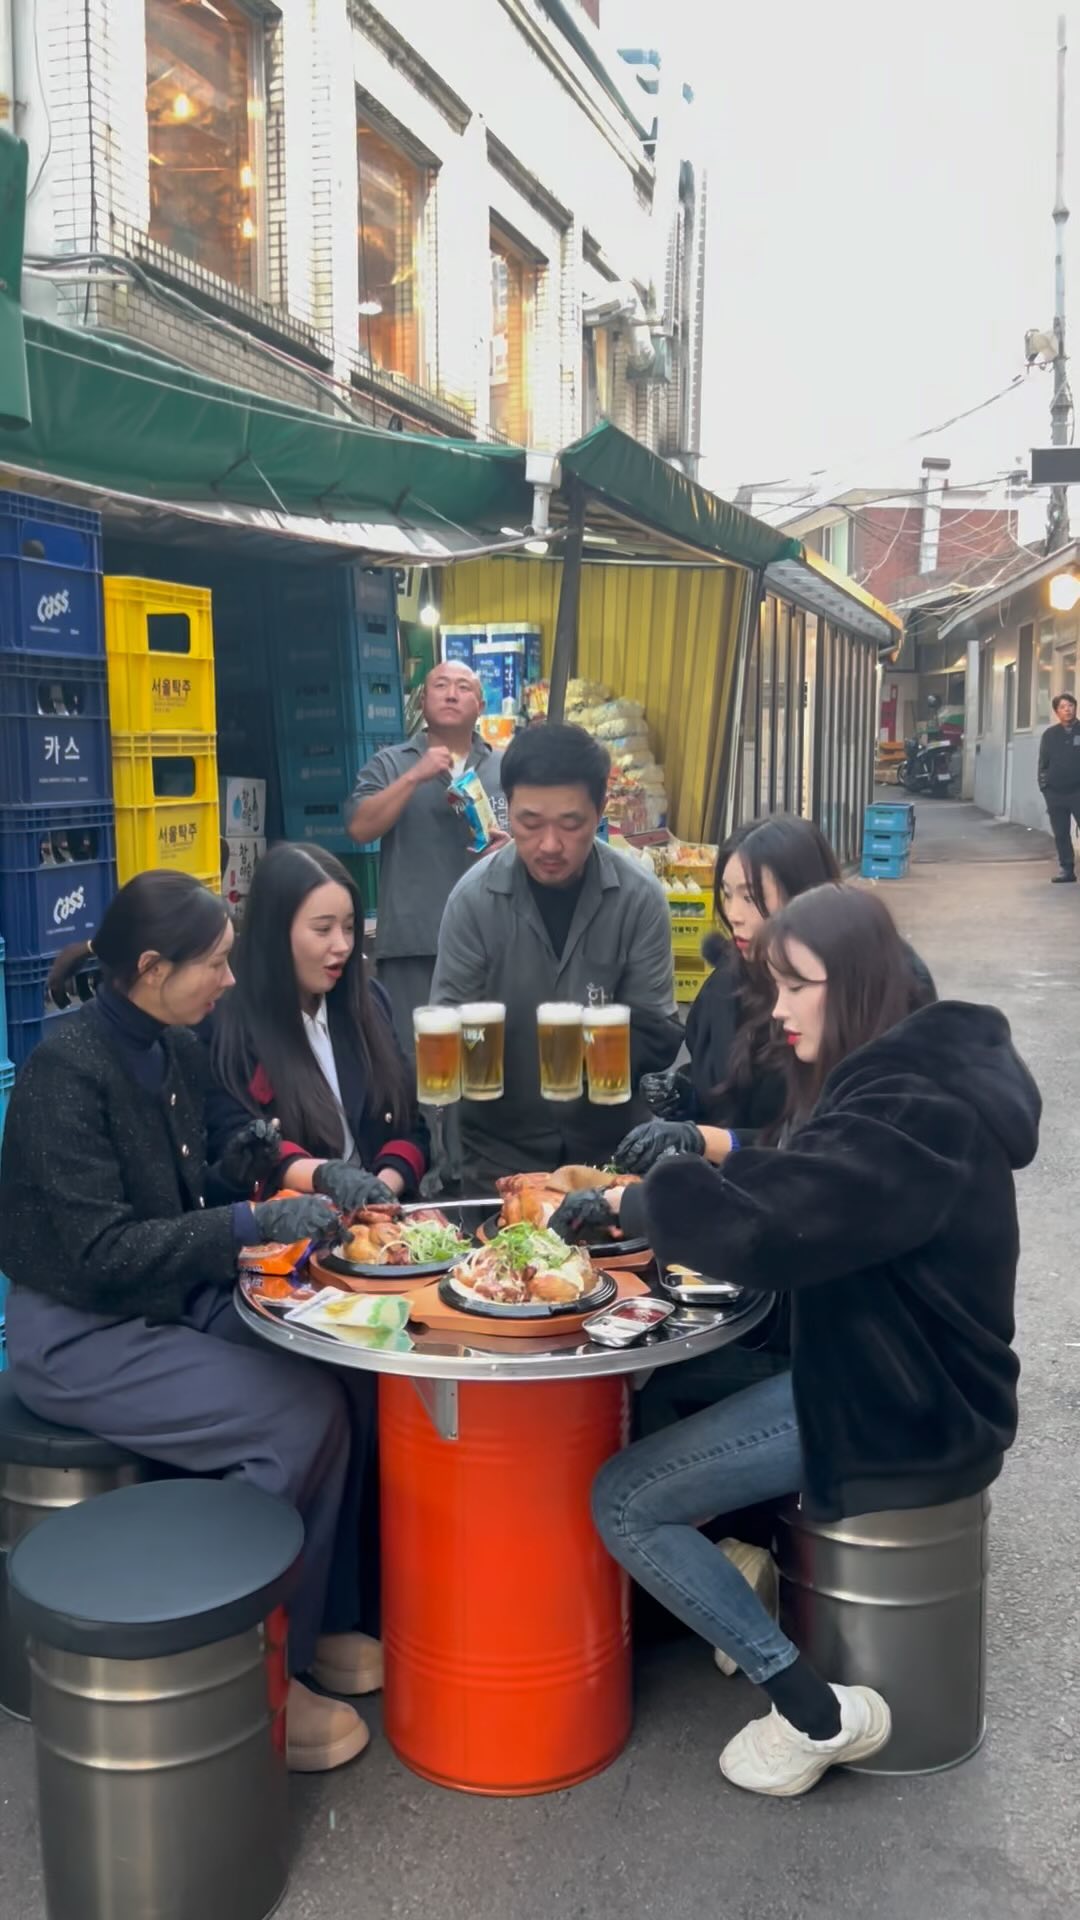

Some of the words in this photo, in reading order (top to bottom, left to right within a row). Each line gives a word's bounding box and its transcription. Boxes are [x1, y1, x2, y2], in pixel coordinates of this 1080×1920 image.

[151, 677, 192, 699] 서울탁주
[44, 735, 80, 765] 카스
[159, 823, 198, 844] 서울탁주
